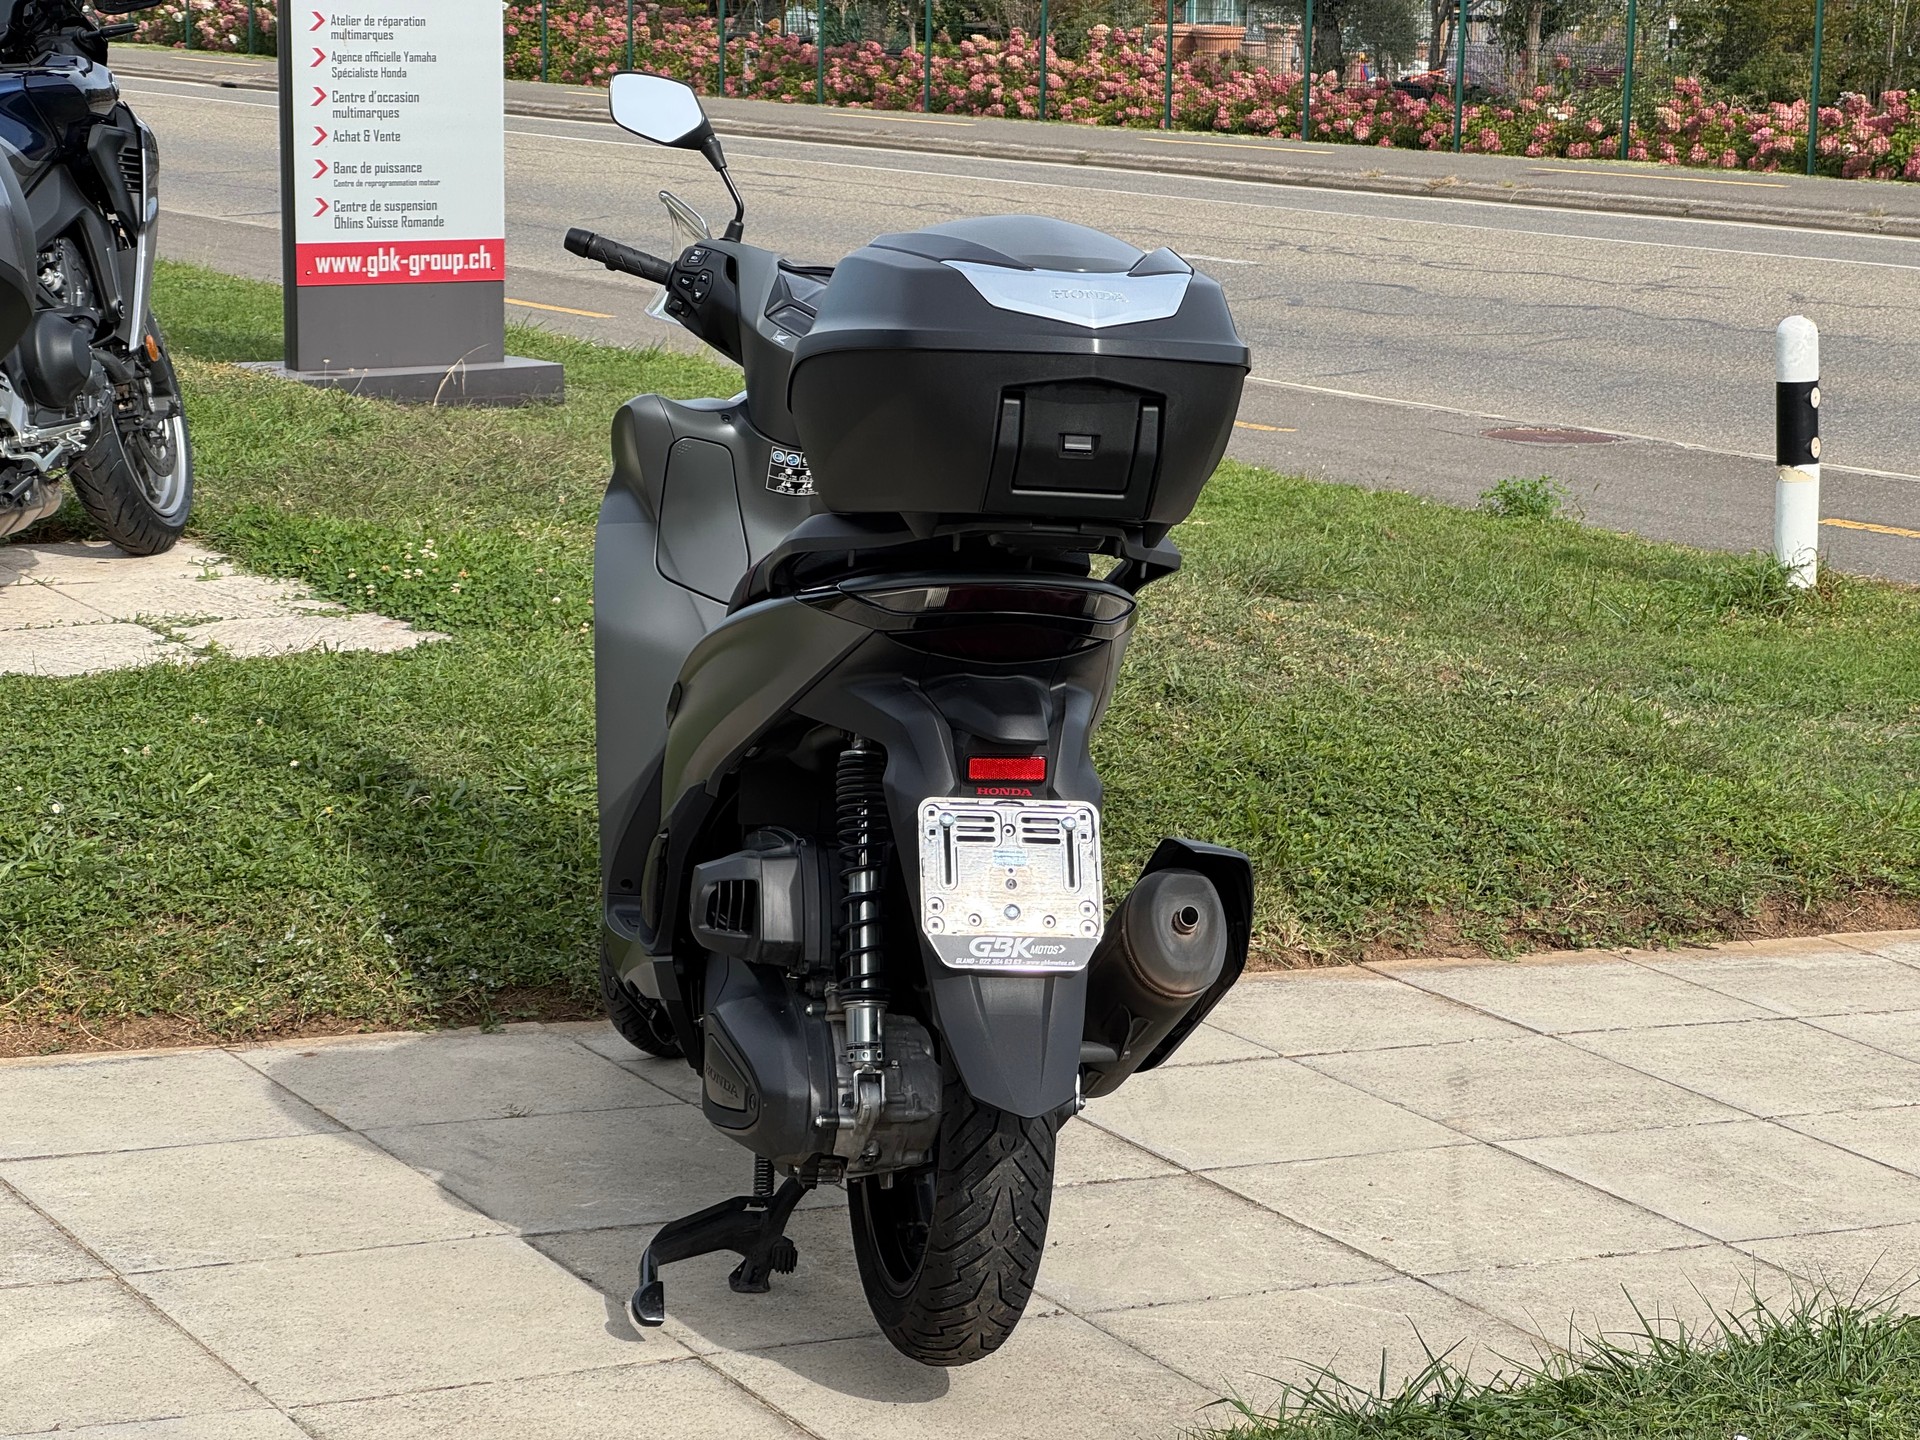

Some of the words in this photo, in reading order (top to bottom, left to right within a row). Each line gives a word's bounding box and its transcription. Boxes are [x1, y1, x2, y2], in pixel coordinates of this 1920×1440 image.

[330, 14, 361, 27] Atelier
[364, 14, 375, 26] de
[378, 15, 426, 28] réparation
[331, 29, 394, 42] multimarques
[331, 51, 363, 65] Agence
[365, 50, 401, 62] officielle
[404, 51, 437, 63] Yamaha
[331, 67, 379, 80] Spécialiste
[381, 66, 407, 78] Honda
[332, 90, 366, 103] Centre
[368, 90, 420, 103] d'occasion
[332, 106, 400, 121] multimarques
[333, 129, 361, 142] Achat
[363, 129, 371, 142] &
[373, 129, 401, 142] Vente
[333, 161, 357, 174] Banc
[360, 161, 372, 174] de
[374, 162, 422, 176] puissance
[333, 179, 355, 188] Centre
[356, 179, 364, 187] de
[365, 179, 417, 189] reprogrammation
[418, 179, 441, 187] moteur
[333, 200, 367, 213] Centre
[370, 200, 382, 212] de
[384, 200, 437, 214] suspension
[334, 215, 364, 229] Öhlins
[366, 215, 399, 228] Suisse
[401, 215, 445, 228] Romande
[315, 245, 491, 278] www.gbk-group.ch
[1050, 289, 1129, 303] HONDA
[977, 787, 1032, 796] HONDA
[1029, 945, 1060, 955] MOTOS
[705, 1062, 739, 1099] HONDA
